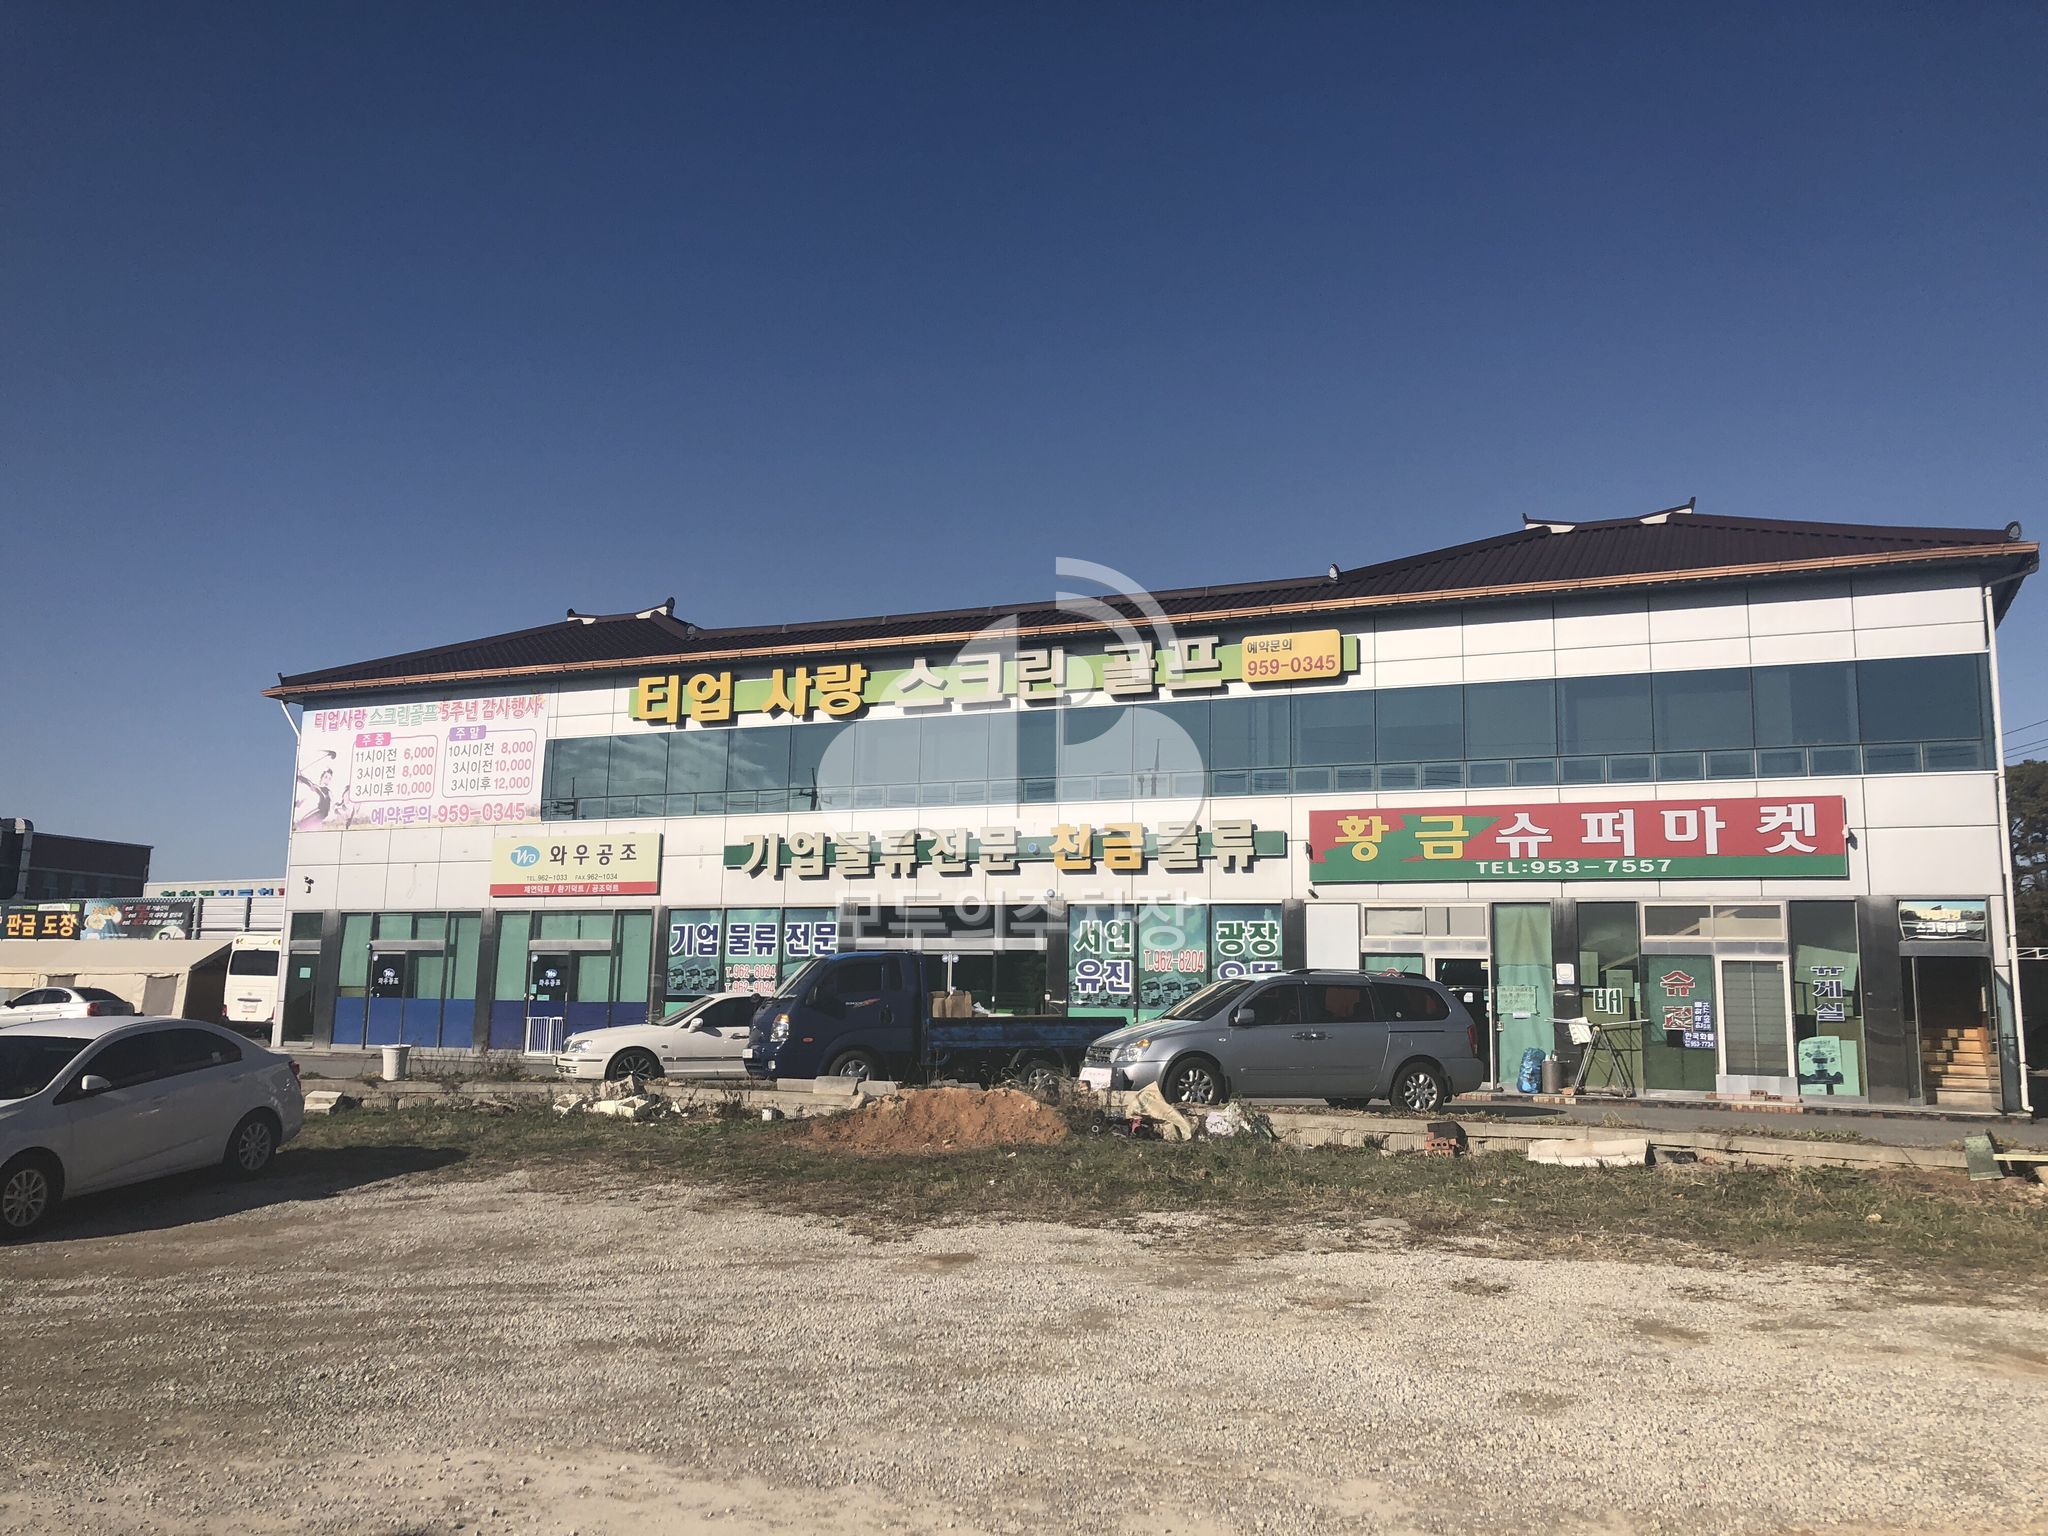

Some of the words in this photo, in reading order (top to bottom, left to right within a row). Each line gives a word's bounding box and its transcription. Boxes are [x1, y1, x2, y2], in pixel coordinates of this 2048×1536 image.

[1247, 638, 1292, 654] 예약문의
[1247, 654, 1336, 676] 959-0345
[638, 672, 732, 722] 티업
[762, 662, 866, 716] 사랑
[895, 646, 1066, 708] 스크린
[1103, 636, 1223, 696] 골프
[314, 708, 367, 732] 티업사랑
[368, 702, 438, 727] 스크린골프
[440, 700, 479, 721] 5주년
[481, 696, 541, 720] 감사행사
[355, 748, 397, 763] 11시이전
[403, 746, 435, 762] 6,000
[448, 742, 495, 758] 10시이전
[500, 740, 534, 756] 8,000
[356, 765, 396, 780] 3시이전
[401, 763, 433, 779] 8,000
[452, 759, 493, 775] 3시이전
[495, 758, 532, 773] 10,000
[355, 782, 394, 797] 3시이후
[395, 781, 432, 796] 10,000
[451, 777, 491, 792] 3시이후
[494, 776, 530, 791] 12,000
[371, 805, 432, 825] 예약문의
[437, 802, 526, 823] 959-0345
[549, 844, 637, 866] 와우공조
[742, 826, 1018, 878] 기업물류전문
[1049, 819, 1254, 872] 천금물류
[6, 913, 37, 936] 판금
[41, 912, 79, 937] 도장
[671, 923, 719, 956] 기업
[728, 923, 777, 956] 물류
[785, 922, 838, 956] 전문
[1074, 920, 1135, 954] 서연
[1216, 920, 1280, 956] 광장
[725, 964, 776, 979] T.962-8024
[1143, 950, 1205, 973] T.962-8204
[1075, 959, 1131, 994] 유진
